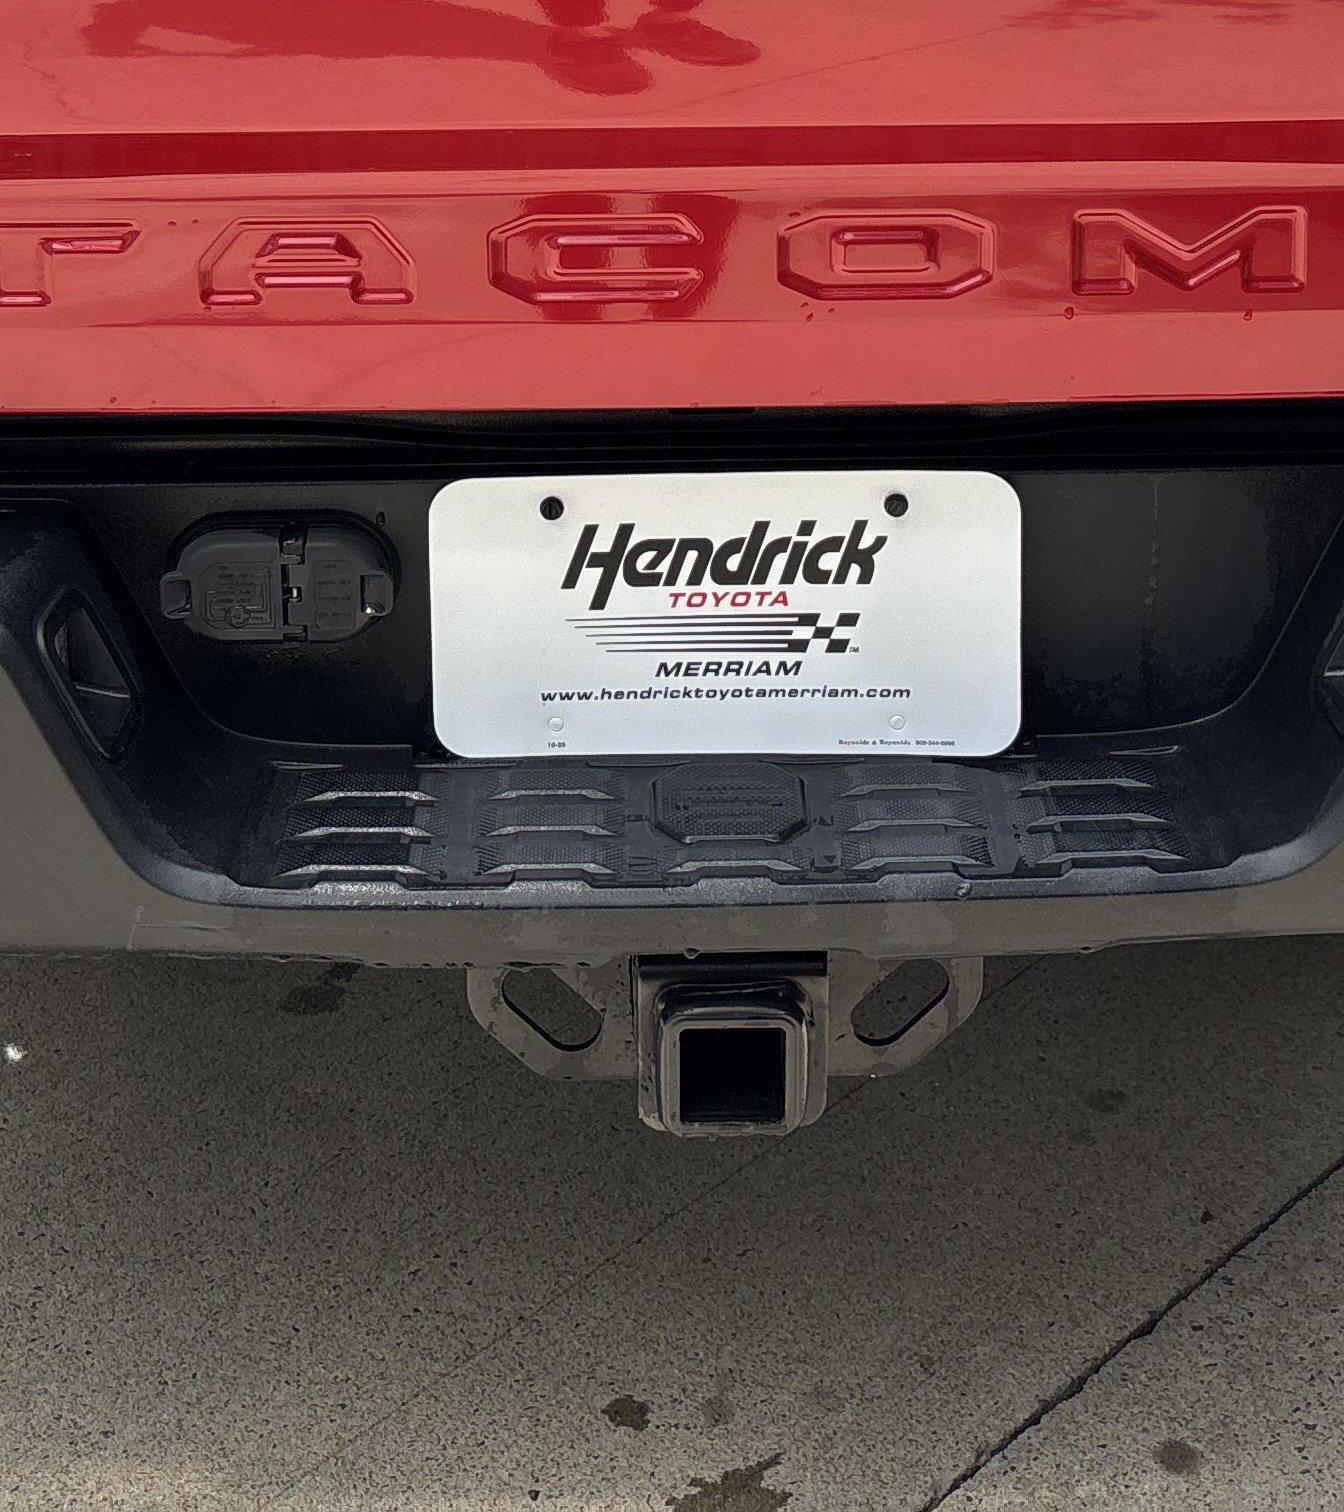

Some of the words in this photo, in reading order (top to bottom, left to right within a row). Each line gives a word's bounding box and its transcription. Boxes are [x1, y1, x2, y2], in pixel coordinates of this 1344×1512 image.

[560, 519, 889, 611] Hendrick
[668, 590, 790, 608] TOYOTA
[654, 660, 803, 678] MERRIAM
[540, 684, 911, 702] www.hendricktoyotamerriam.com
